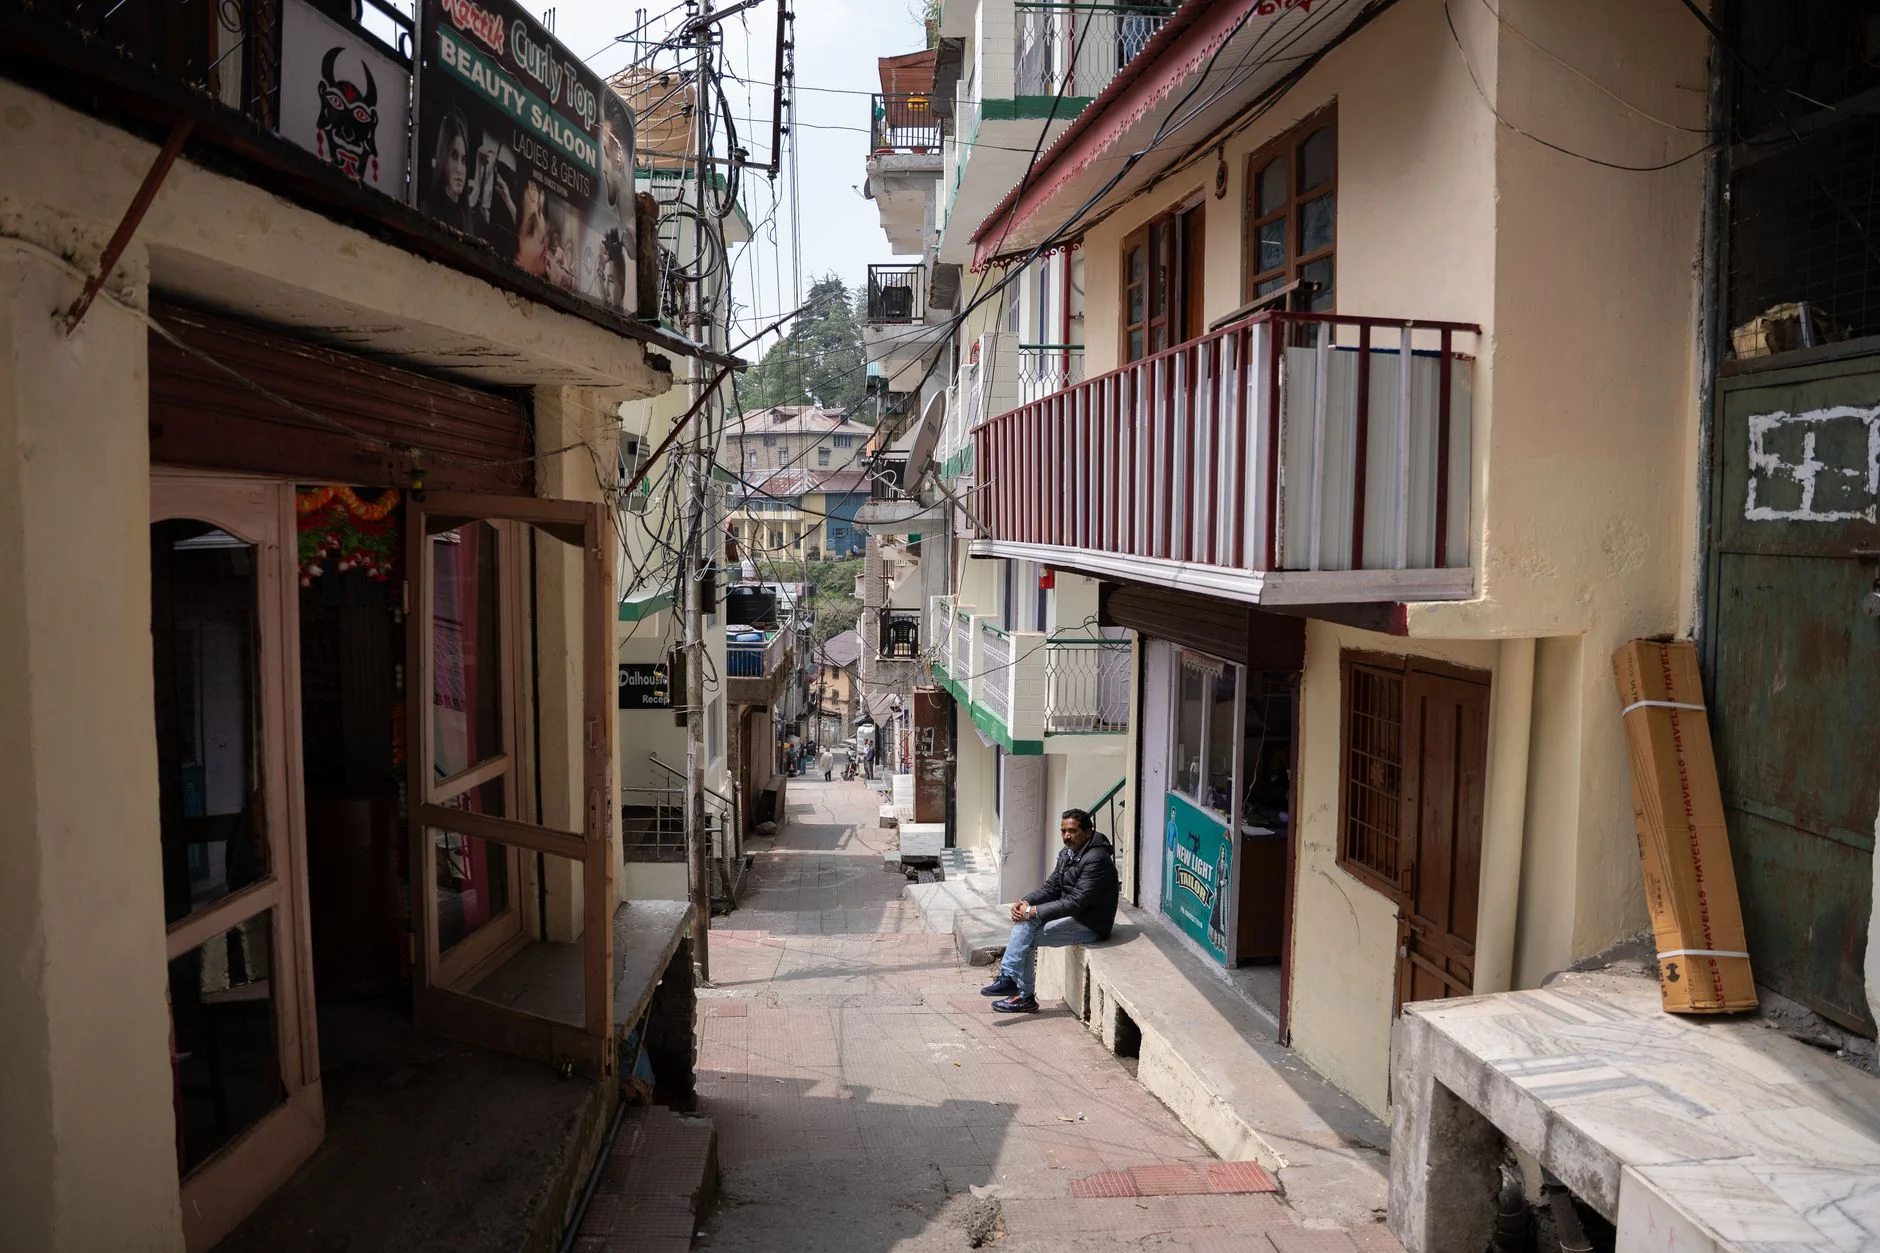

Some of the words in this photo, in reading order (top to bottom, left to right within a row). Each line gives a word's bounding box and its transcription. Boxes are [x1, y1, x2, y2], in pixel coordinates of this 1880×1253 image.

[511, 20, 563, 104] Curly
[441, 34, 526, 115] BEAUTY
[531, 104, 596, 168] SALOON
[513, 129, 548, 170] LADIES
[551, 155, 558, 177] &
[560, 162, 590, 197] GENTS
[1677, 759, 1694, 817] HAVELLS
[1176, 843, 1192, 866] NEW
[1192, 853, 1213, 882] LIGHT
[1689, 823, 1704, 883] HAVELLS
[1179, 871, 1208, 902] TAILOR
[1697, 890, 1715, 951] HAVELLS
